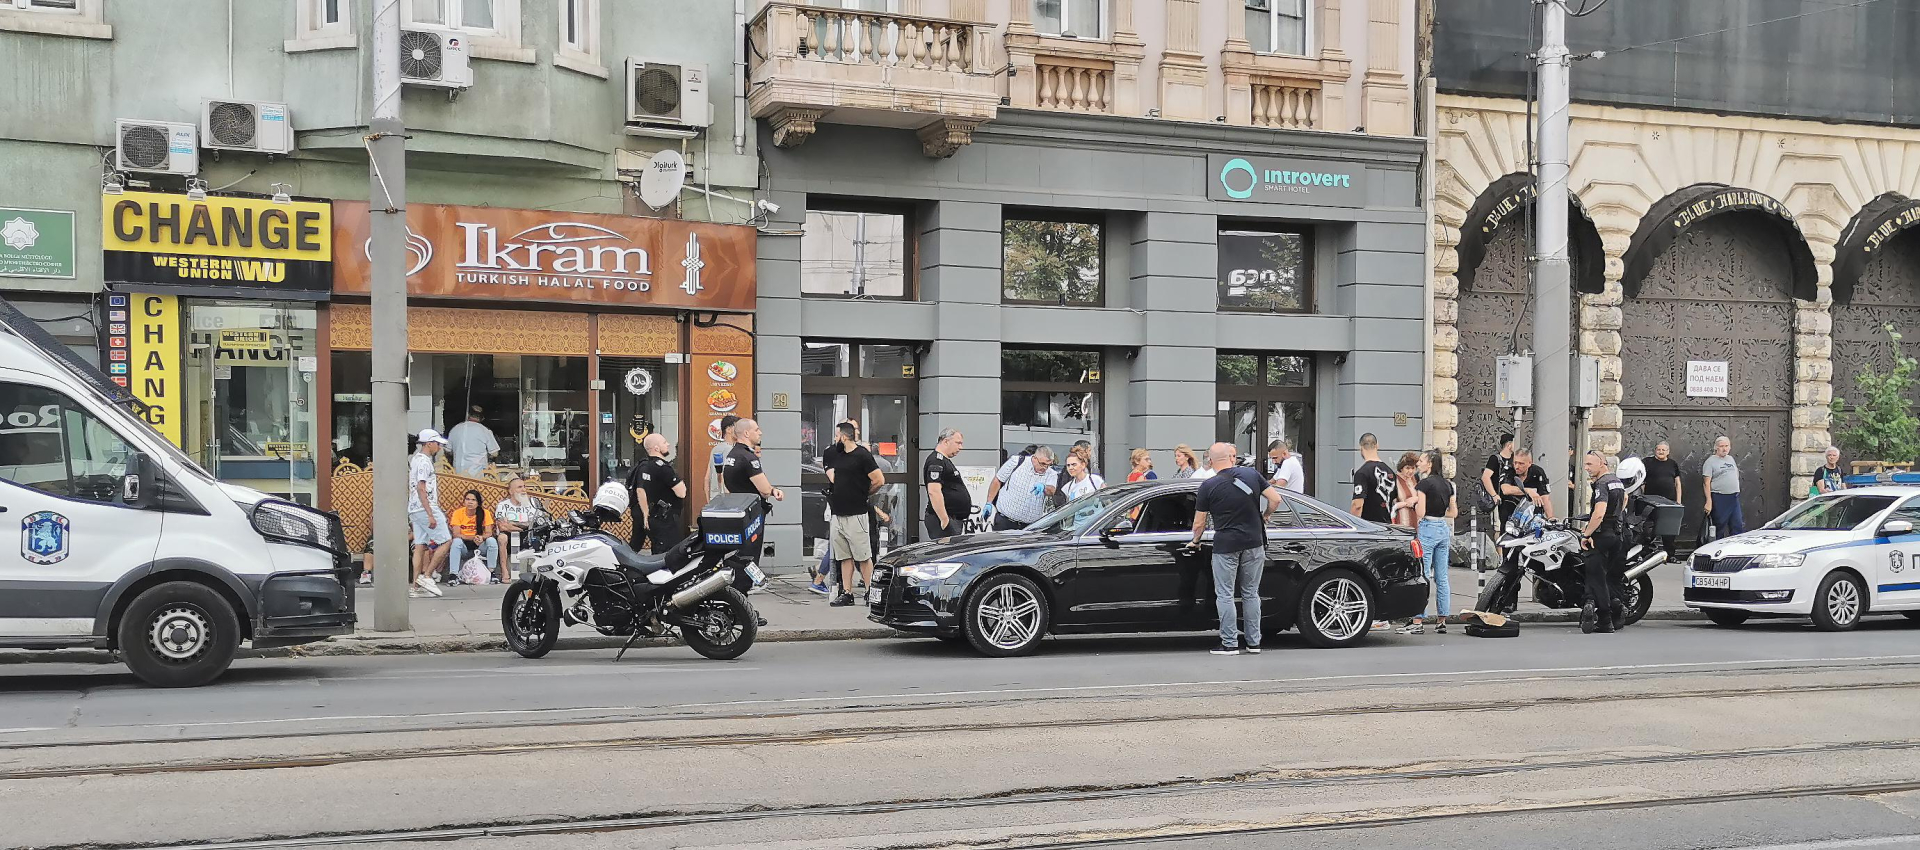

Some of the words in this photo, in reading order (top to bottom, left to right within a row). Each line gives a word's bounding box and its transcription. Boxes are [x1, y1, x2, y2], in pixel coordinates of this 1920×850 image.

[1288, 186, 1310, 194] HOTEL
[112, 199, 322, 251] CHANGE
[455, 222, 653, 276] Ikram
[152, 256, 232, 270] WESTERN
[178, 267, 233, 280] UNION
[456, 272, 530, 286] TURKISH
[538, 276, 595, 290] HALAL
[603, 280, 651, 293] FOOD
[144, 296, 165, 436] CHANG
[1693, 364, 1712, 373] ДАВА
[1713, 365, 1721, 373] СЕ
[1690, 375, 1705, 383] ПОД
[1706, 375, 1725, 383] НАЕМ
[773, 393, 788, 407] 29
[1395, 412, 1406, 424] 29
[747, 516, 761, 536] POLICE
[708, 533, 740, 544] POLICE
[547, 542, 588, 556] POLICE
